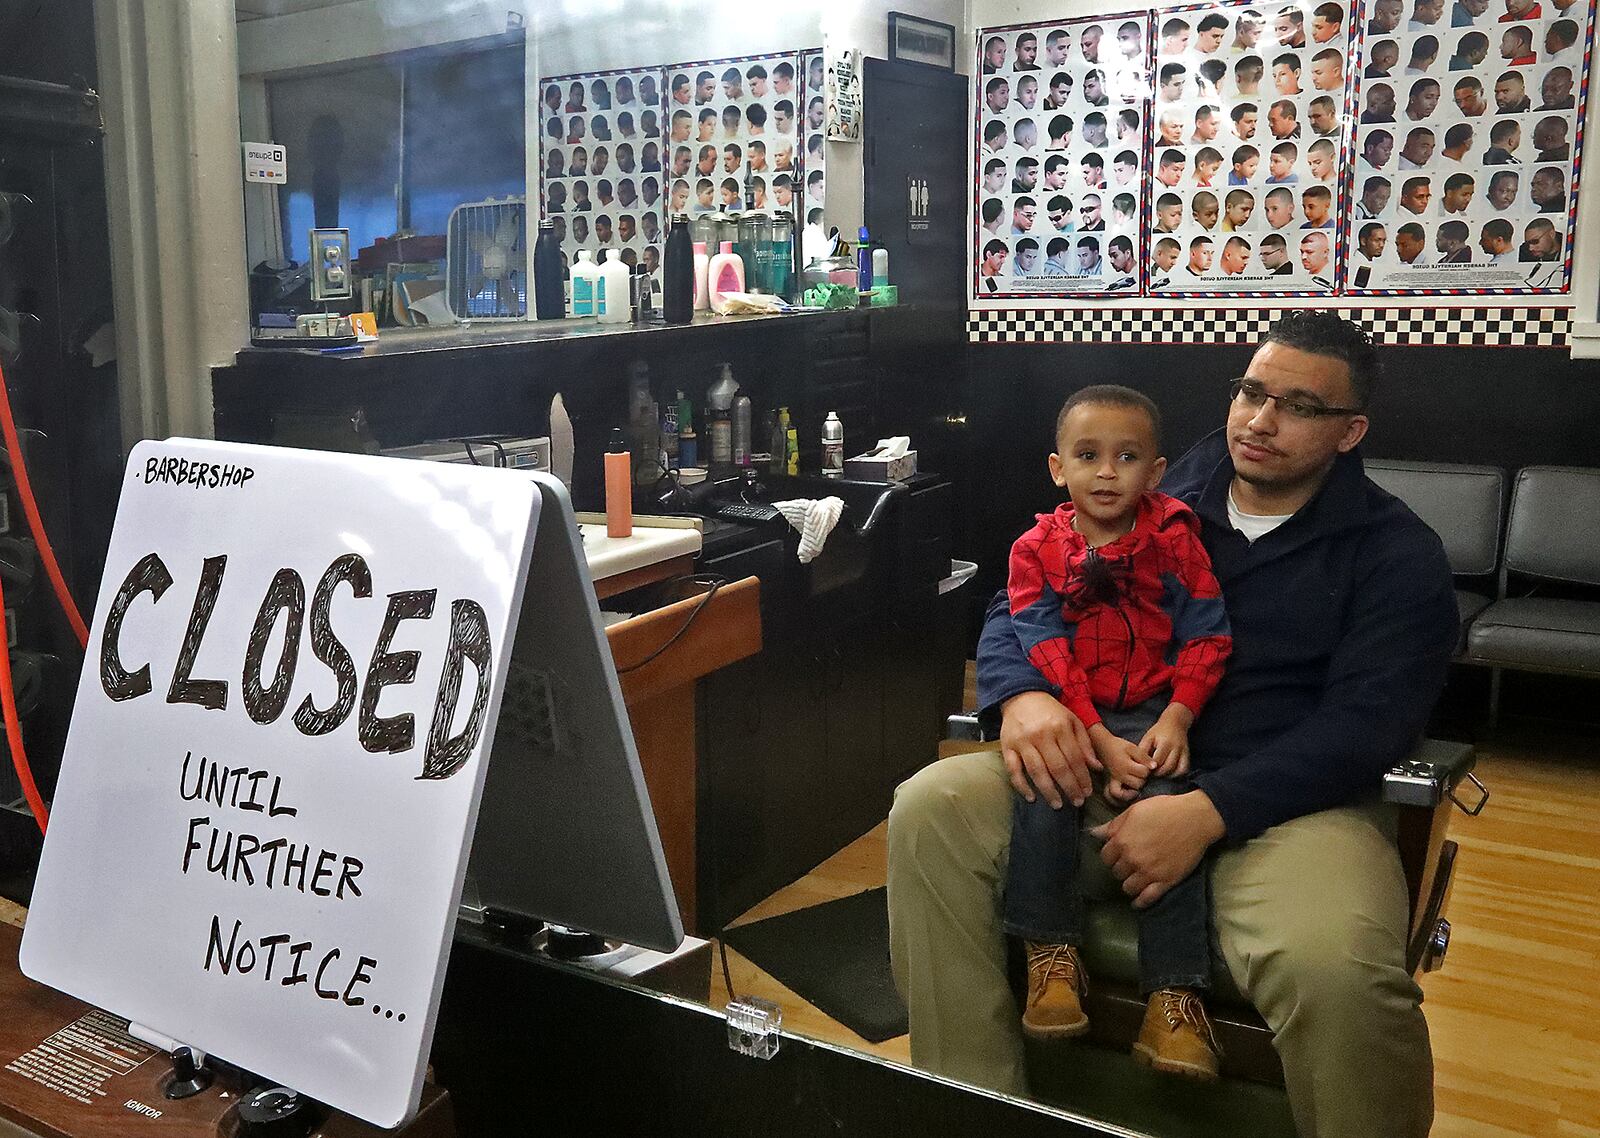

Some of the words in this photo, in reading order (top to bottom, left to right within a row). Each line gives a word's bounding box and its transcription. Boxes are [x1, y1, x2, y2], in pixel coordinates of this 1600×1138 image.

[99, 553, 492, 780] CLOSED
[179, 751, 298, 817] UNTIL
[182, 817, 364, 900] FURTHER
[123, 1099, 163, 1120] IGNITOR
